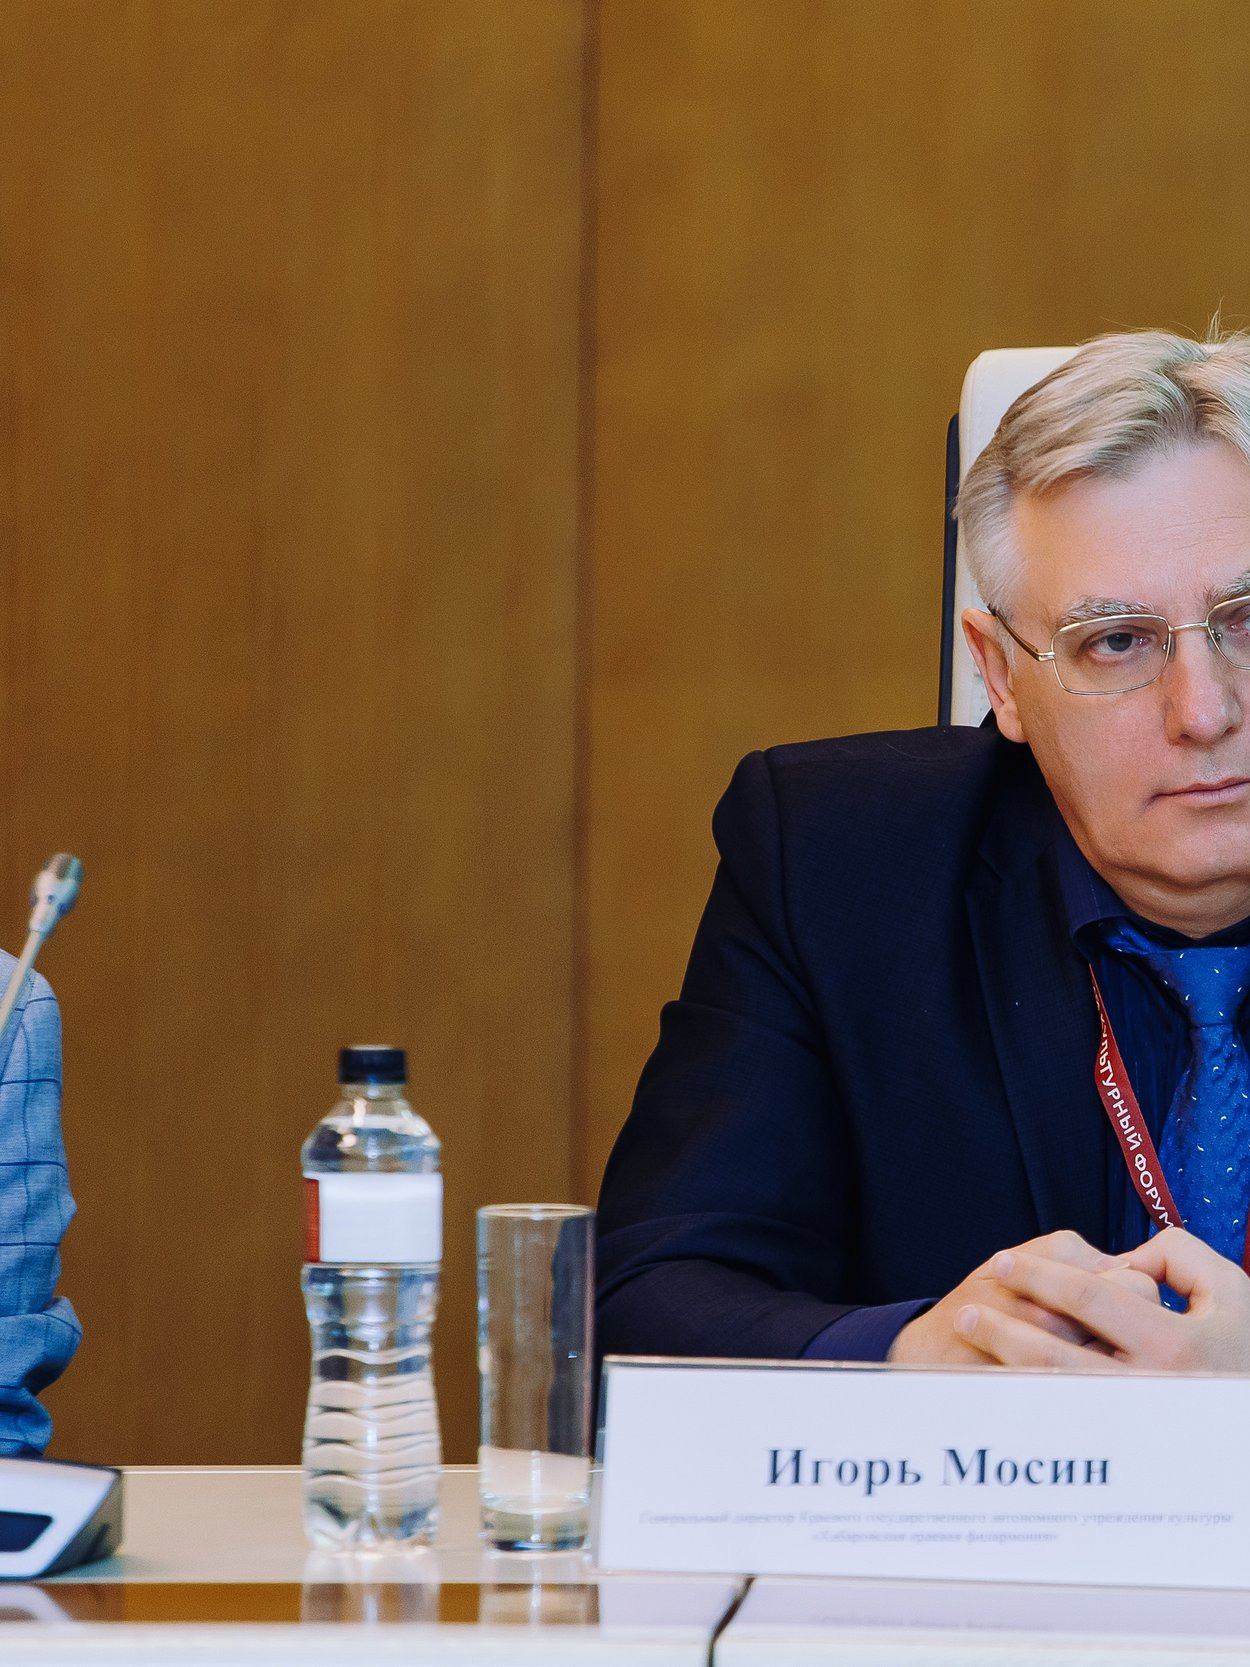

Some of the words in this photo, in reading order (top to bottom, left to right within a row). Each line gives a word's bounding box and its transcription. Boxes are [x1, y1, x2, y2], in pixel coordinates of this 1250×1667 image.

[1099, 1012, 1143, 1151] ЛЬТУРНЫЙ
[1134, 1153, 1175, 1229] ФОРУМ
[765, 1447, 922, 1496] Игорь
[941, 1447, 1112, 1487] Мосин
